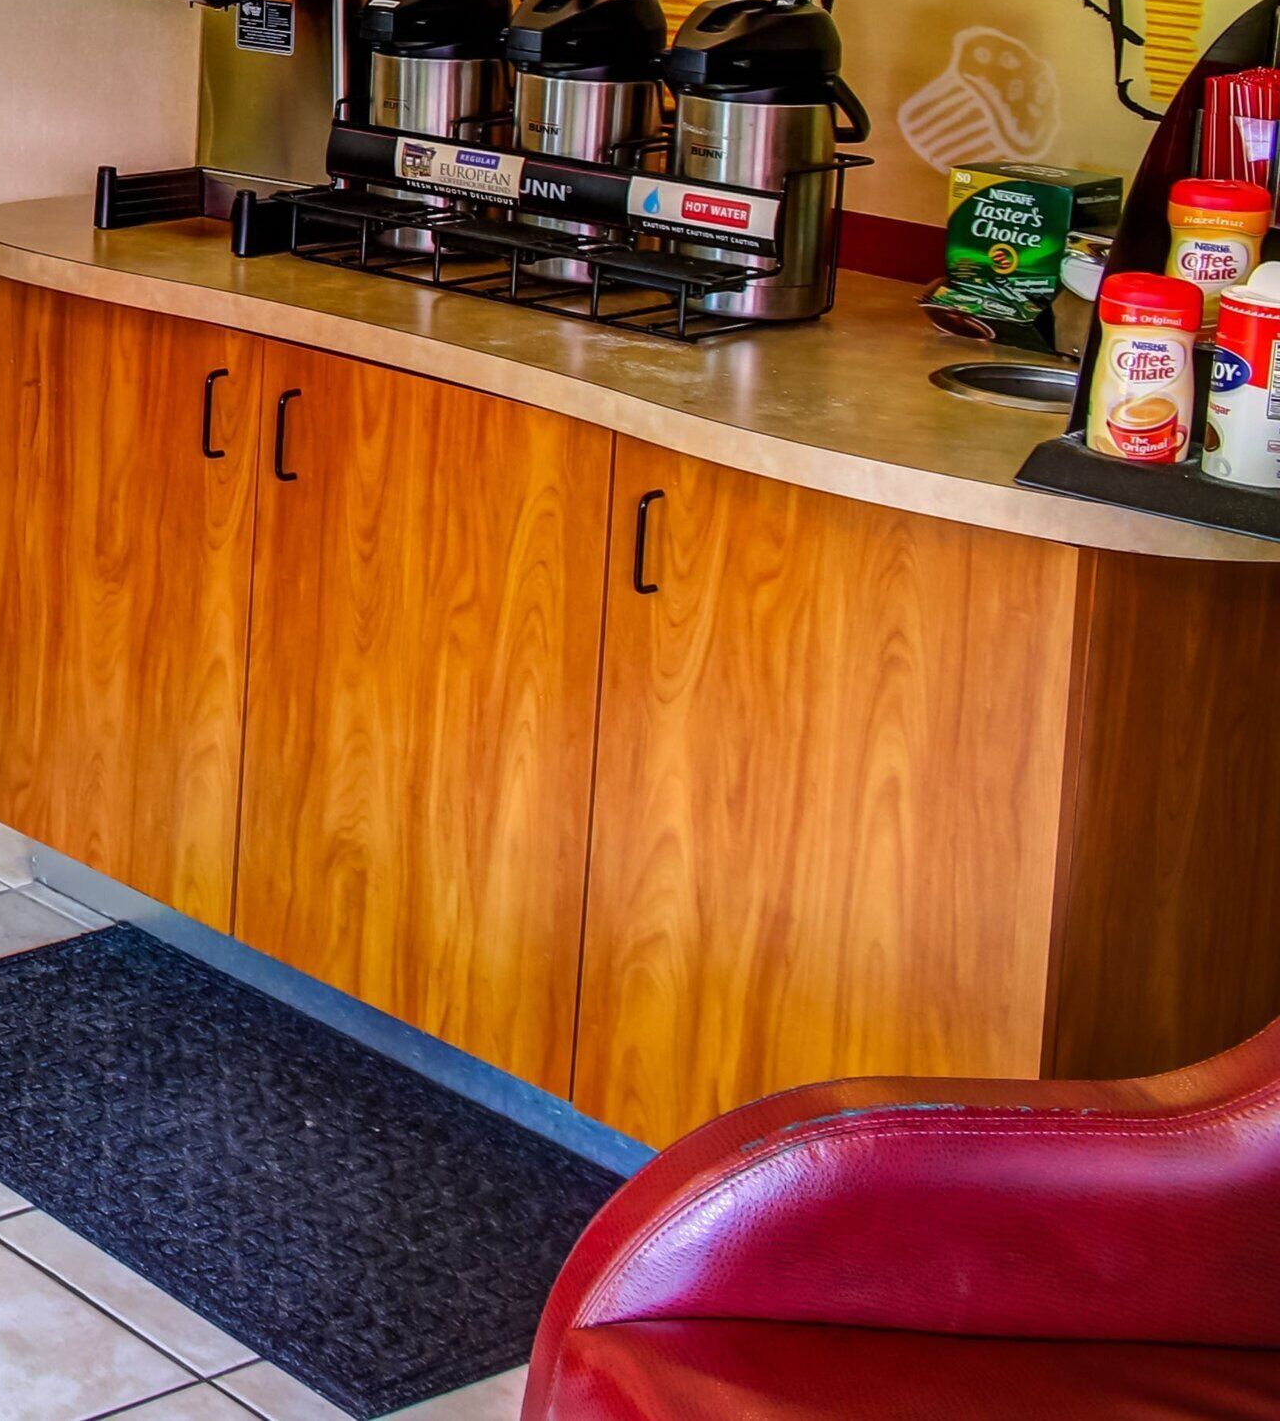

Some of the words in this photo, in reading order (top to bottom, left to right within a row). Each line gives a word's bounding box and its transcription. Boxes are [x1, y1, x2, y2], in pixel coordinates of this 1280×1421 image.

[528, 123, 561, 135] BUNN
[459, 154, 497, 166] REGULAR
[690, 146, 724, 160] BUNN
[440, 162, 512, 187] EUROPEAN
[406, 179, 432, 191] FRESH
[434, 185, 468, 197] SMOOTH
[470, 191, 514, 206] DELICIOUS
[685, 202, 709, 213] HOT
[711, 205, 748, 221] WATER
[972, 196, 1044, 228] Taster's
[1183, 215, 1245, 228] Hazelnut
[642, 221, 671, 232] CAUTION
[686, 228, 715, 240] CAUTION
[730, 236, 760, 248] CAUTION
[970, 218, 1042, 248] Choice
[1120, 314, 1137, 323] The
[1140, 314, 1182, 327] Original
[1128, 366, 1175, 381] mate
[1209, 401, 1231, 416] ugar
[1122, 441, 1169, 455] Original
[1129, 436, 1150, 446] The
